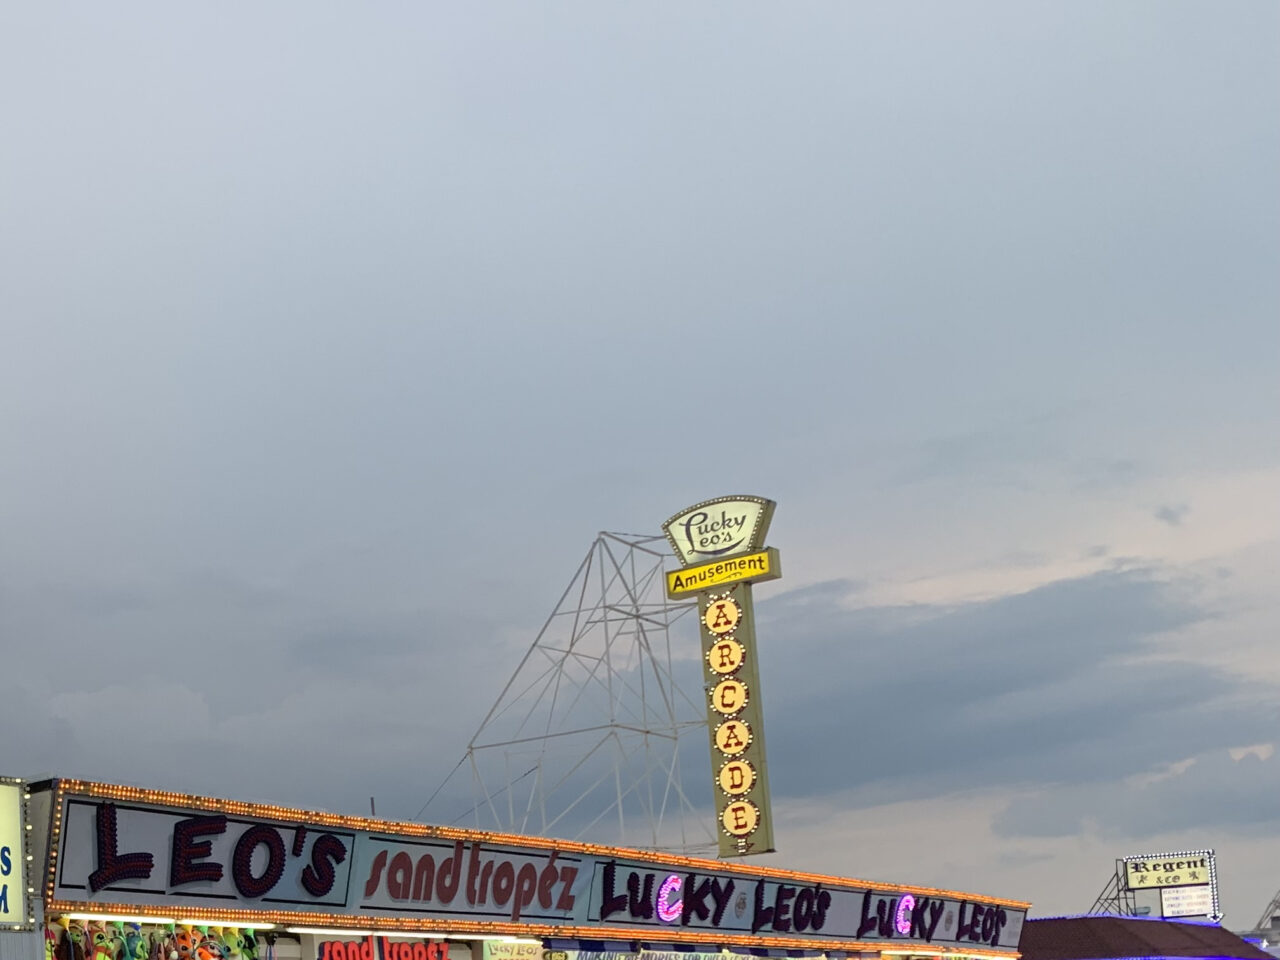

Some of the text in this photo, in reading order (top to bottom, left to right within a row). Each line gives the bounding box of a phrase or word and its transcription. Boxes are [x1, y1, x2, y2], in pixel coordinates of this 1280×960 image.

[673, 556, 766, 592] Amusement
[712, 604, 748, 830] ARCADE
[88, 802, 348, 898] LEO'S
[1130, 858, 1207, 873] Regent
[600, 860, 734, 926] LUCKY
[857, 890, 943, 942] LUCKY
